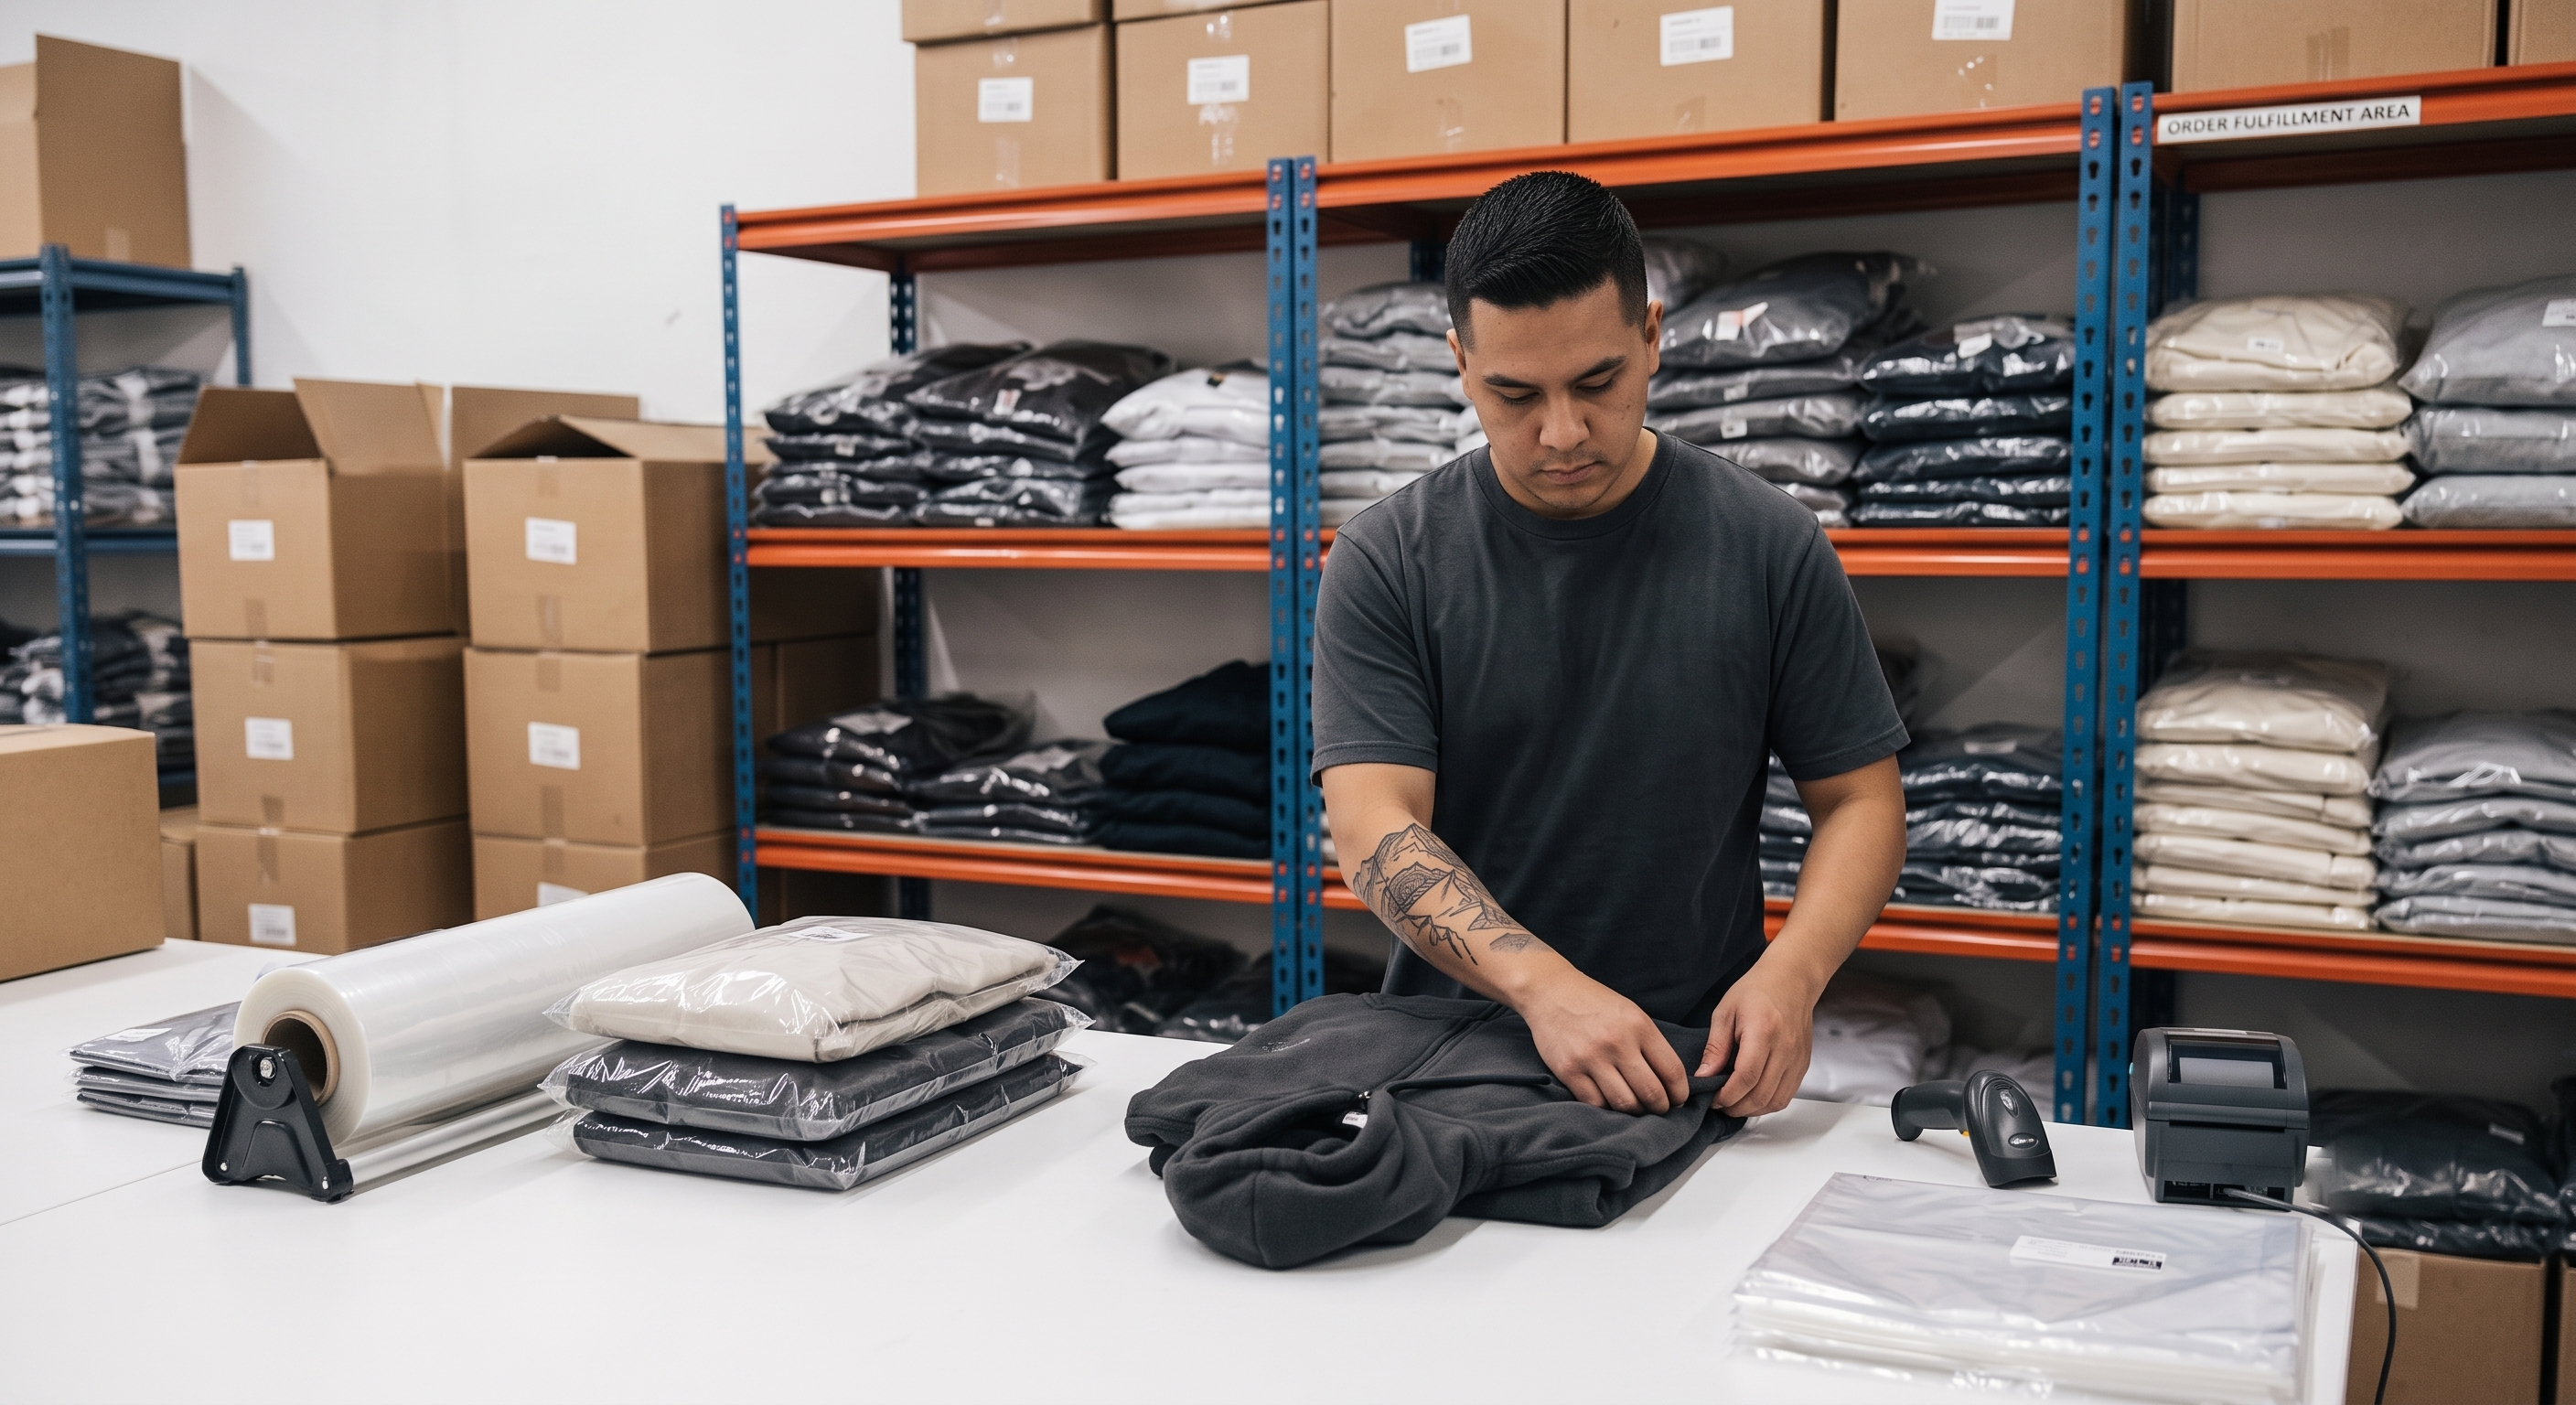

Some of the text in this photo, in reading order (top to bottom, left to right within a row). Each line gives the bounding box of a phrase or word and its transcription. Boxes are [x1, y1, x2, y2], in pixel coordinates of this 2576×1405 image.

[2167, 104, 2410, 134] ORDER FULFILLMENT AREA
